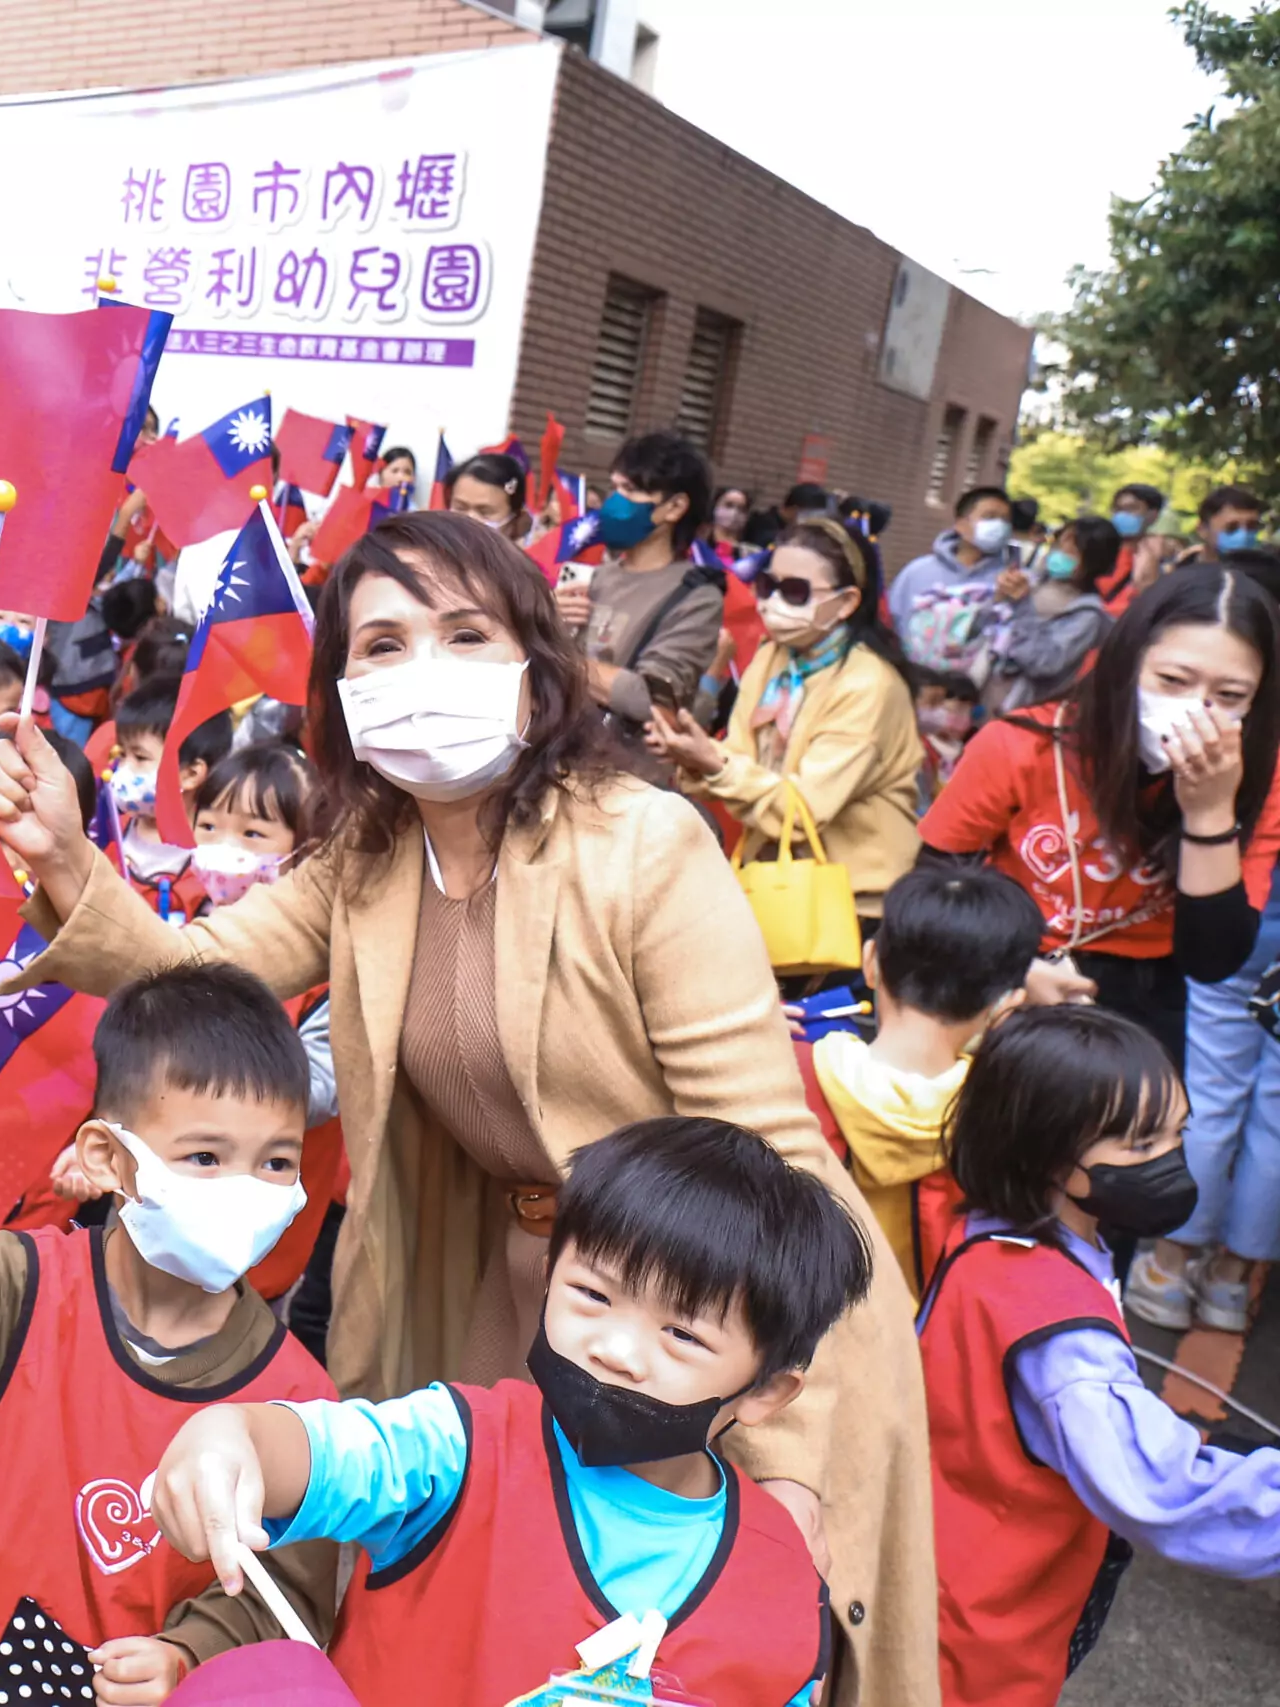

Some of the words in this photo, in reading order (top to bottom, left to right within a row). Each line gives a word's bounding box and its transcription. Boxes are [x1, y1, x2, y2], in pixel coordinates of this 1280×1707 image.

[120, 154, 457, 224] 桃園市內壢
[80, 243, 482, 312] 非營利幼兒園
